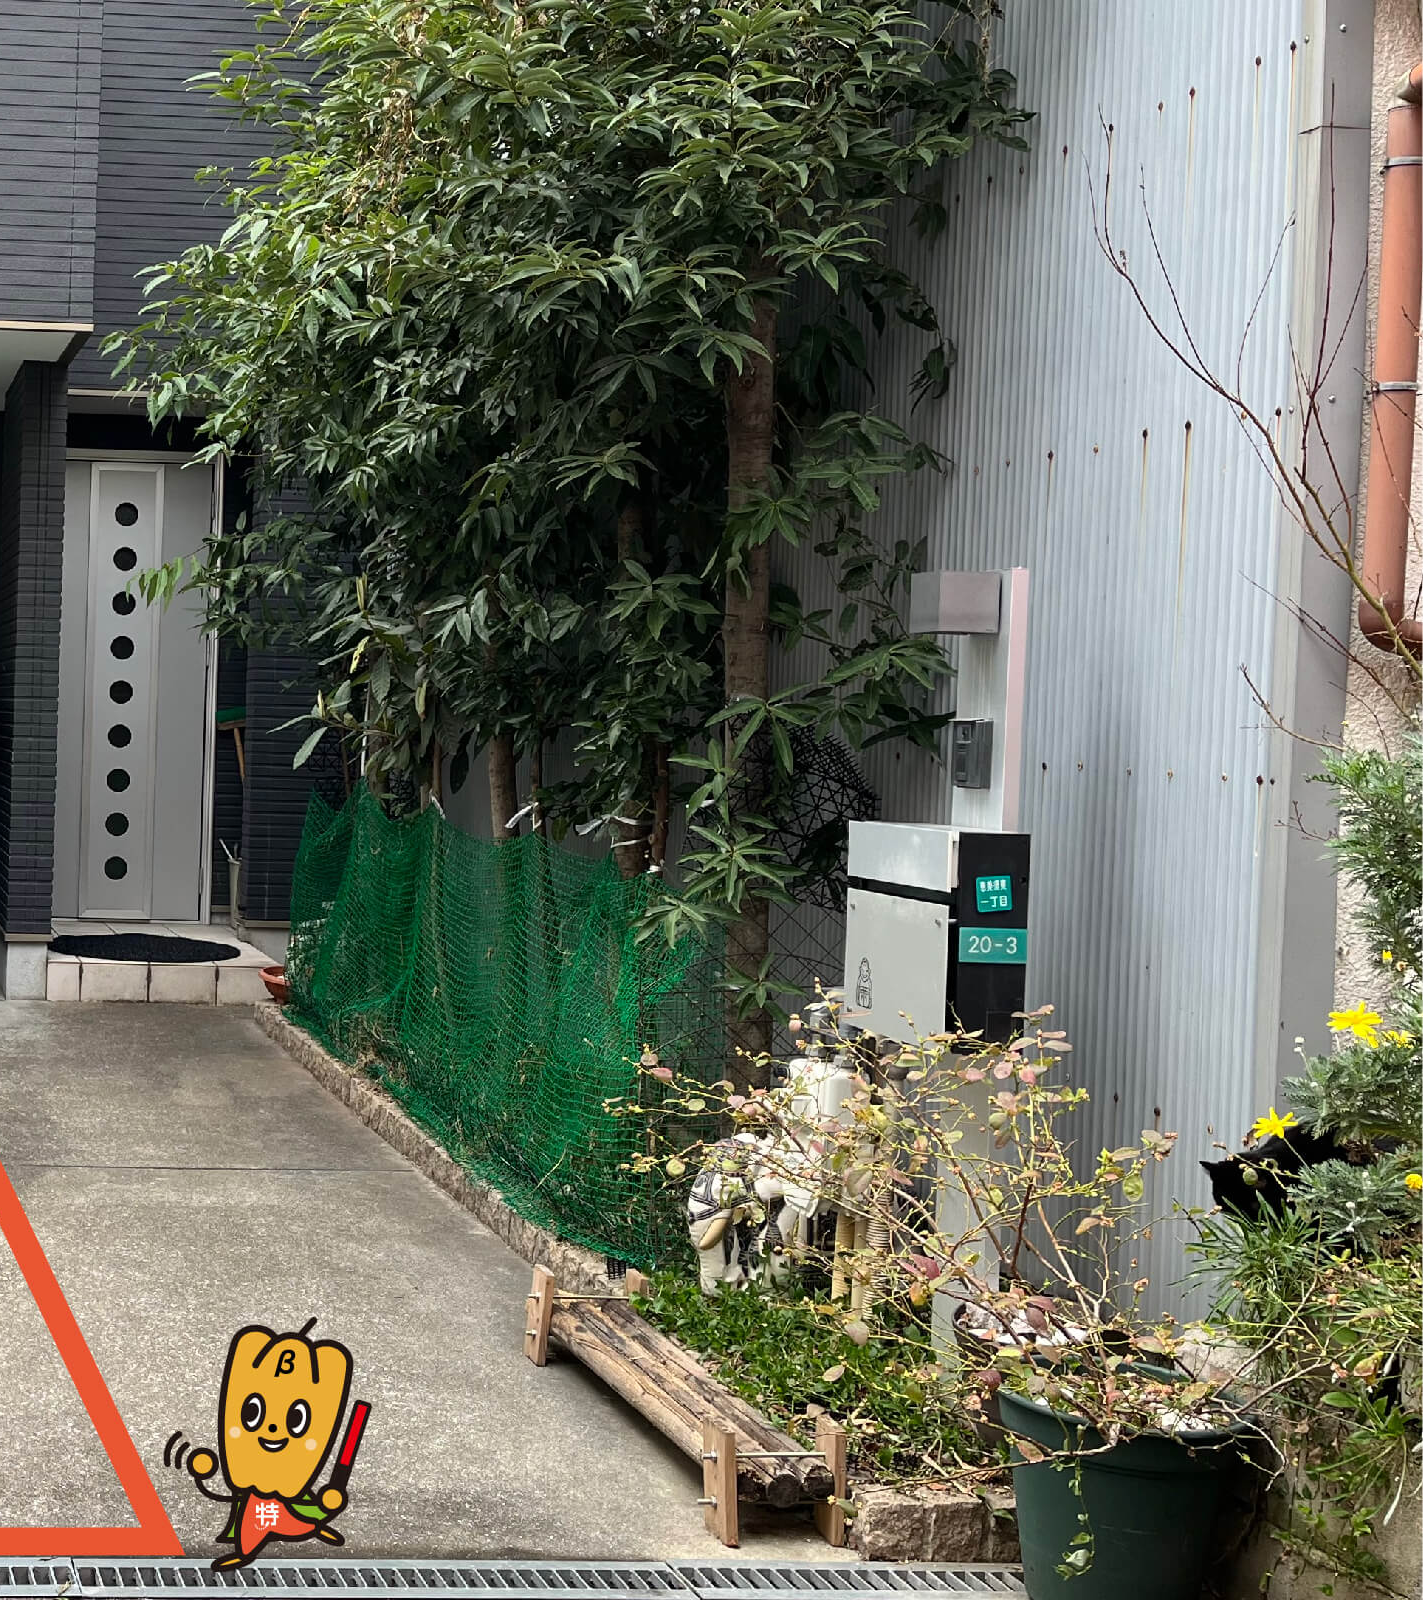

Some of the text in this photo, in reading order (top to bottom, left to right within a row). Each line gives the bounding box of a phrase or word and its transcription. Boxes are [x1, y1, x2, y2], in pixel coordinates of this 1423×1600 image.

[980, 895, 1008, 908] 一丁目
[968, 935, 1018, 955] 20-3
